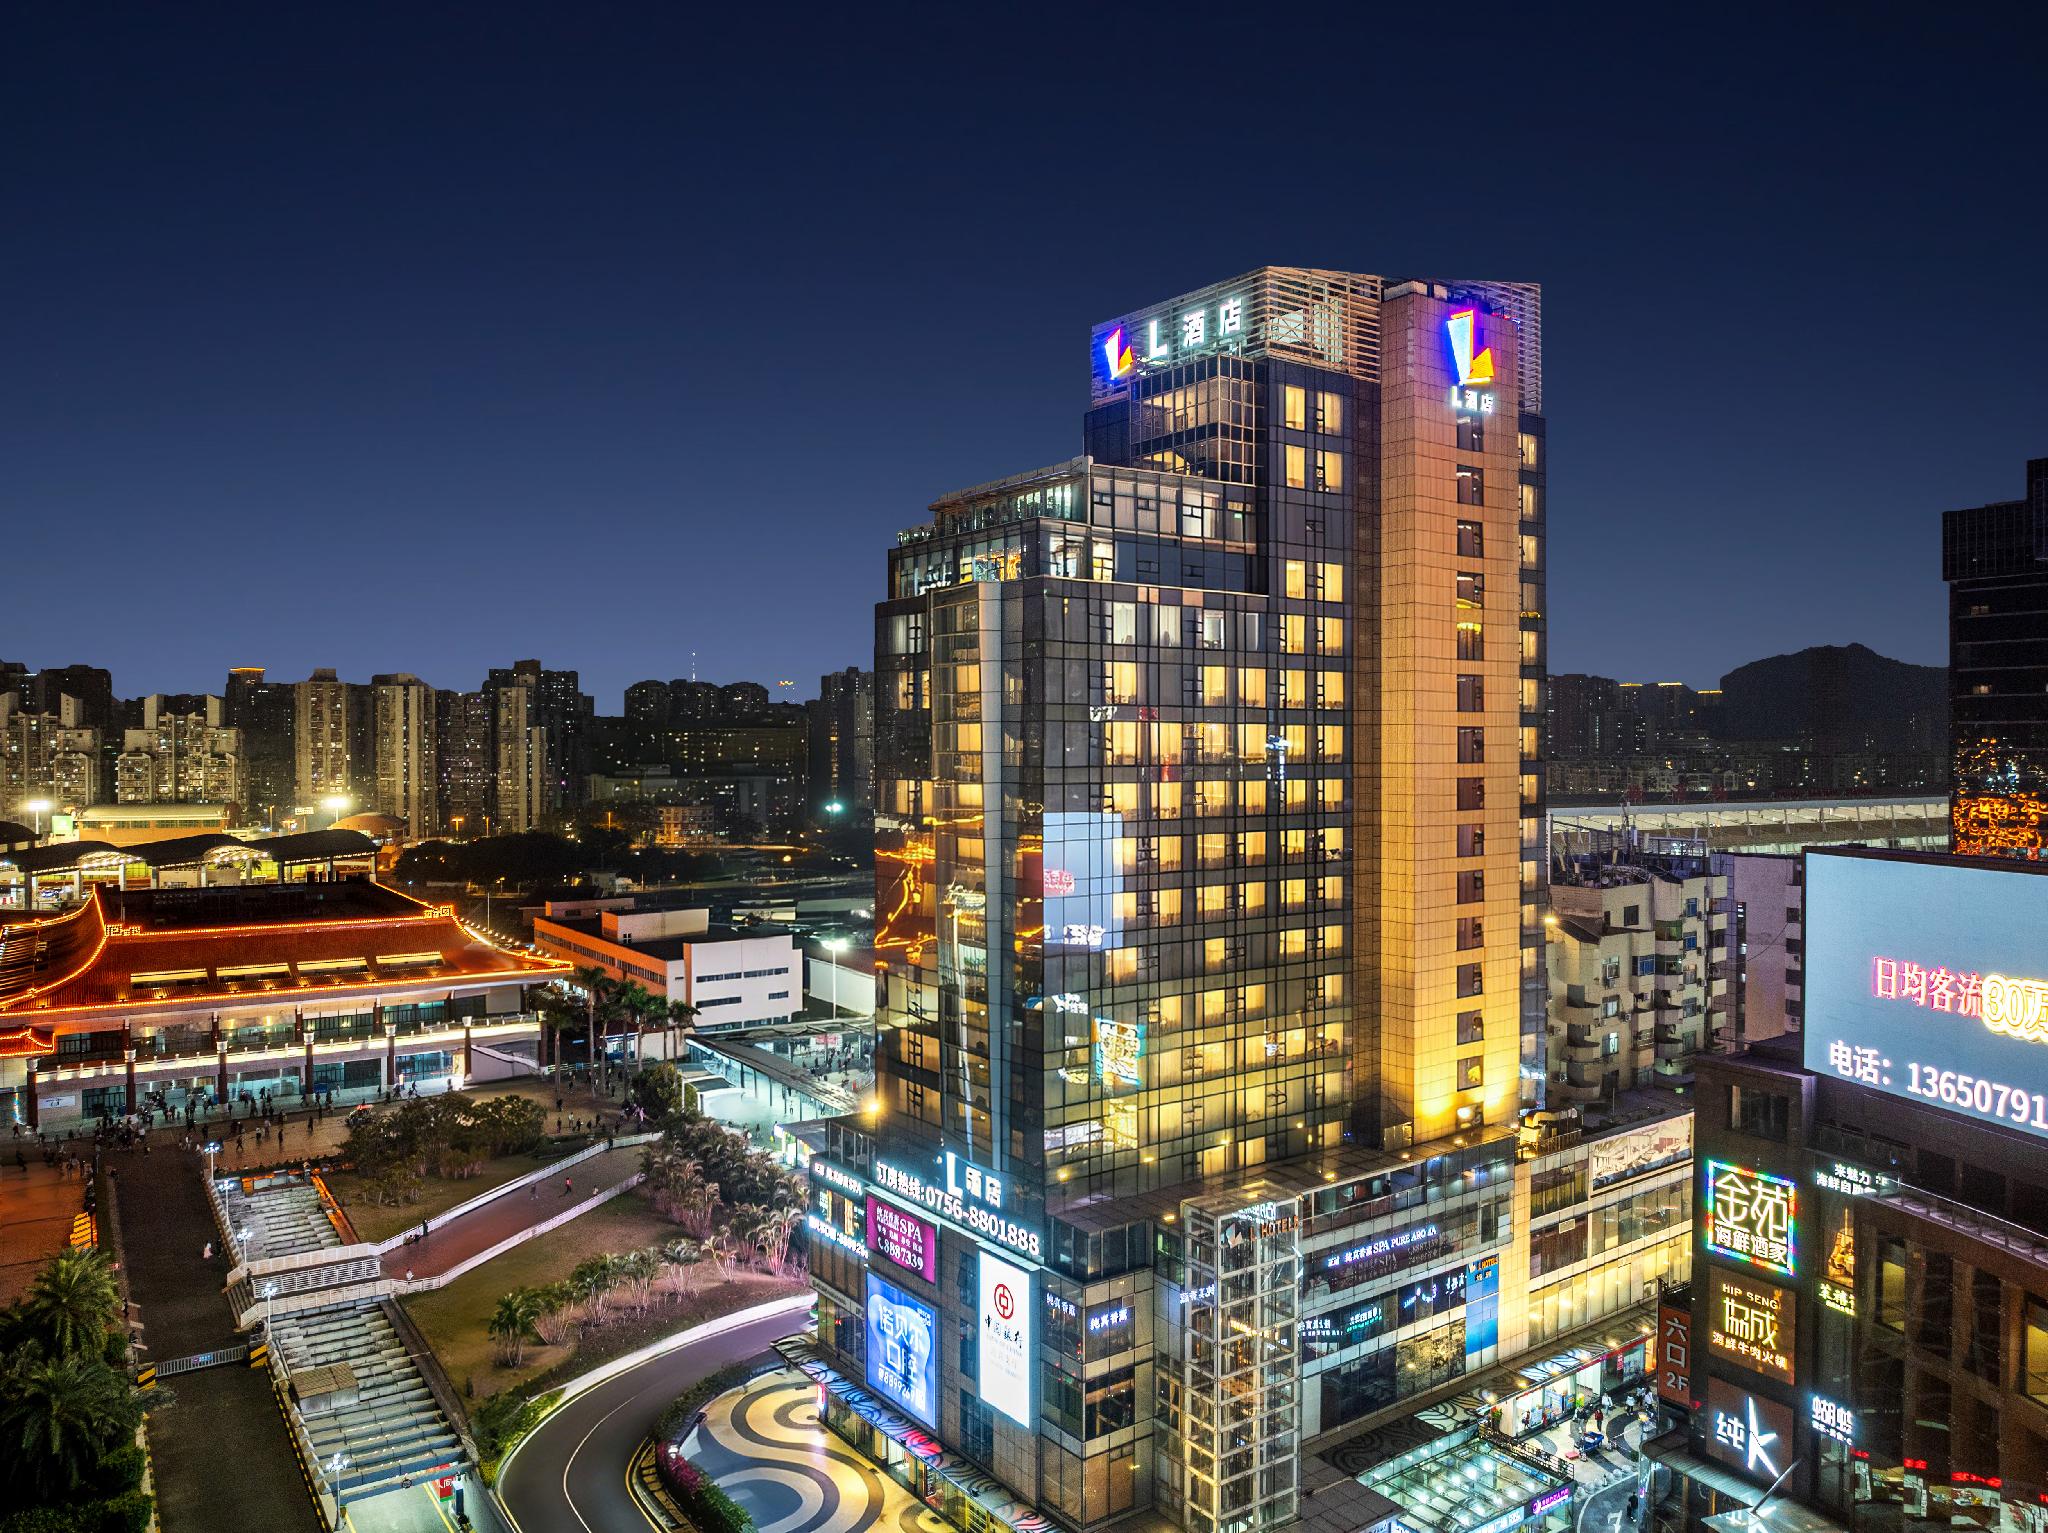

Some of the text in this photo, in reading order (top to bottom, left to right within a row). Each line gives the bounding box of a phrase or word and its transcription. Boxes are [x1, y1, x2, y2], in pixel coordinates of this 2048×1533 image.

[1714, 1172, 1788, 1243] 金苑
[900, 1218, 922, 1243] SPA
[1391, 1234, 1410, 1248] PURE
[1722, 1283, 1778, 1310] HIP SENG
[886, 1339, 919, 1383] 口腔
[1666, 1371, 1689, 1391] 2F
